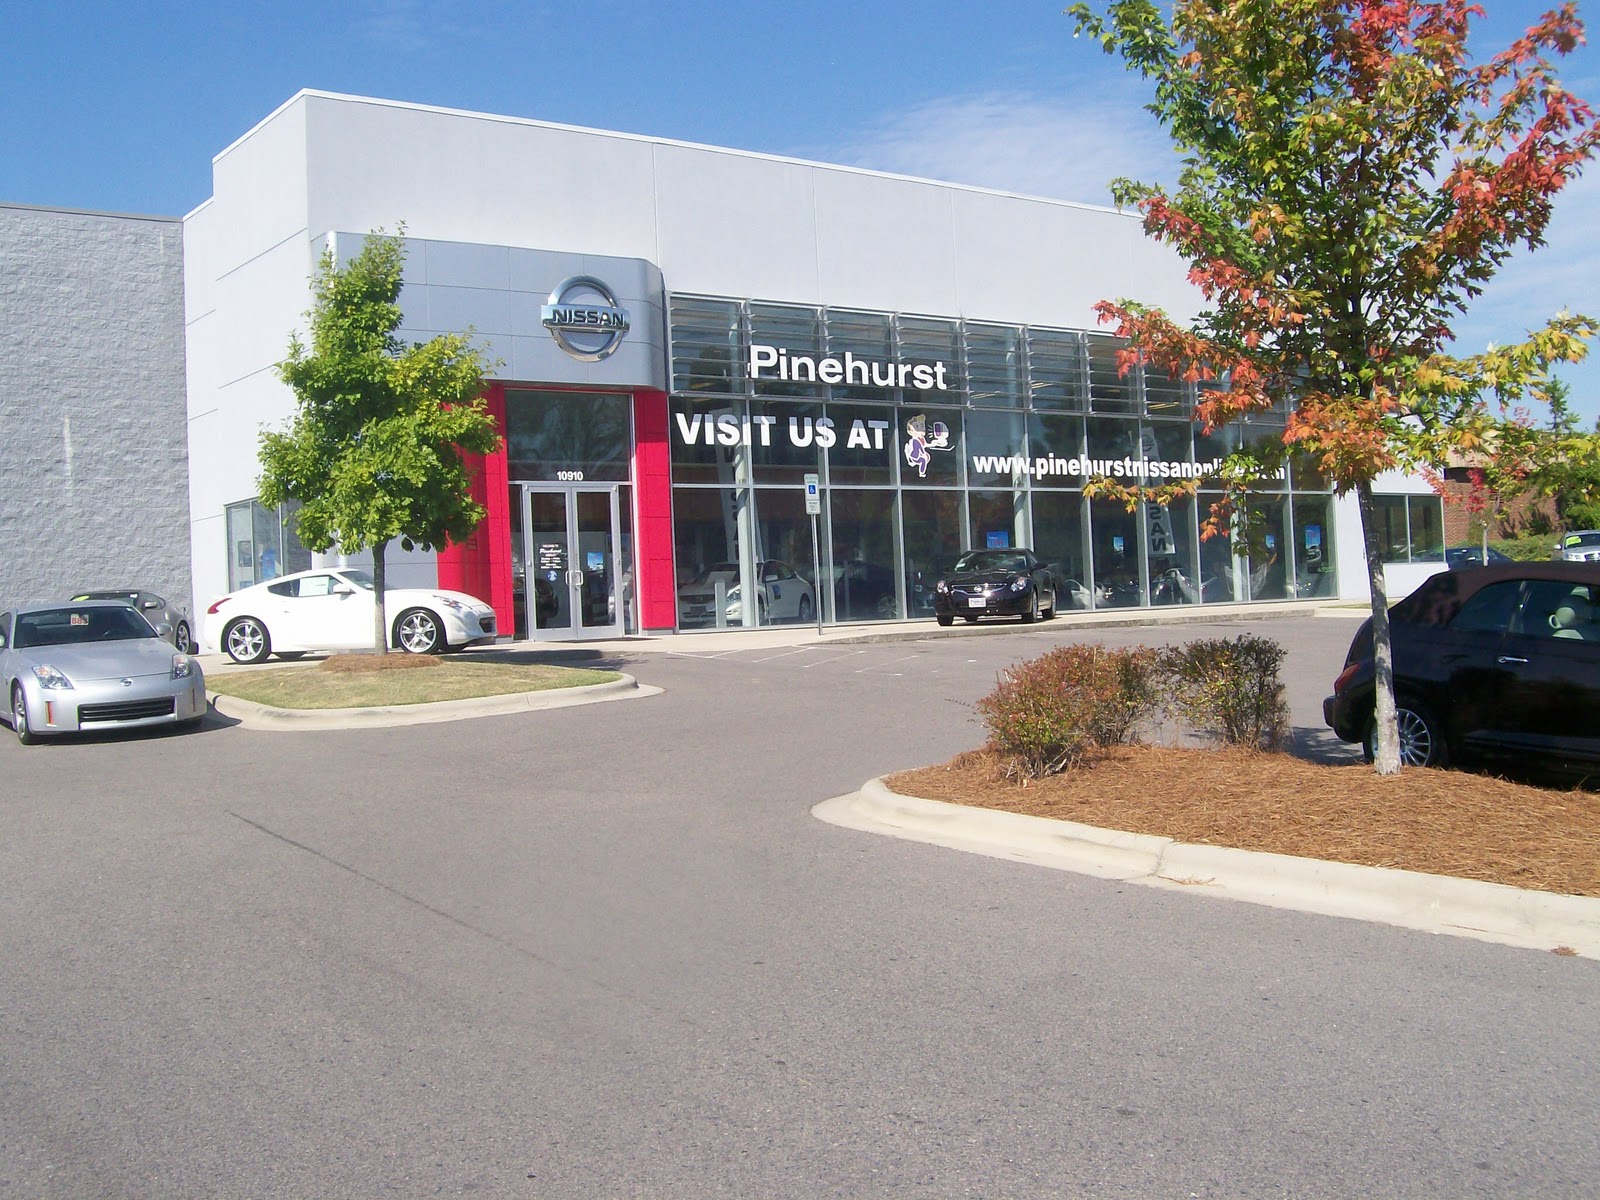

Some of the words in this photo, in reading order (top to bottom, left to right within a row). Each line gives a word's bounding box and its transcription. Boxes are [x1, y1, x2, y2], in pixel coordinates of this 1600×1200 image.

[552, 309, 625, 326] NISSAN
[751, 345, 947, 389] Pinehurst
[675, 412, 776, 446] VISIT
[789, 416, 837, 448] US
[847, 419, 889, 450] AT
[556, 470, 584, 481] 10910
